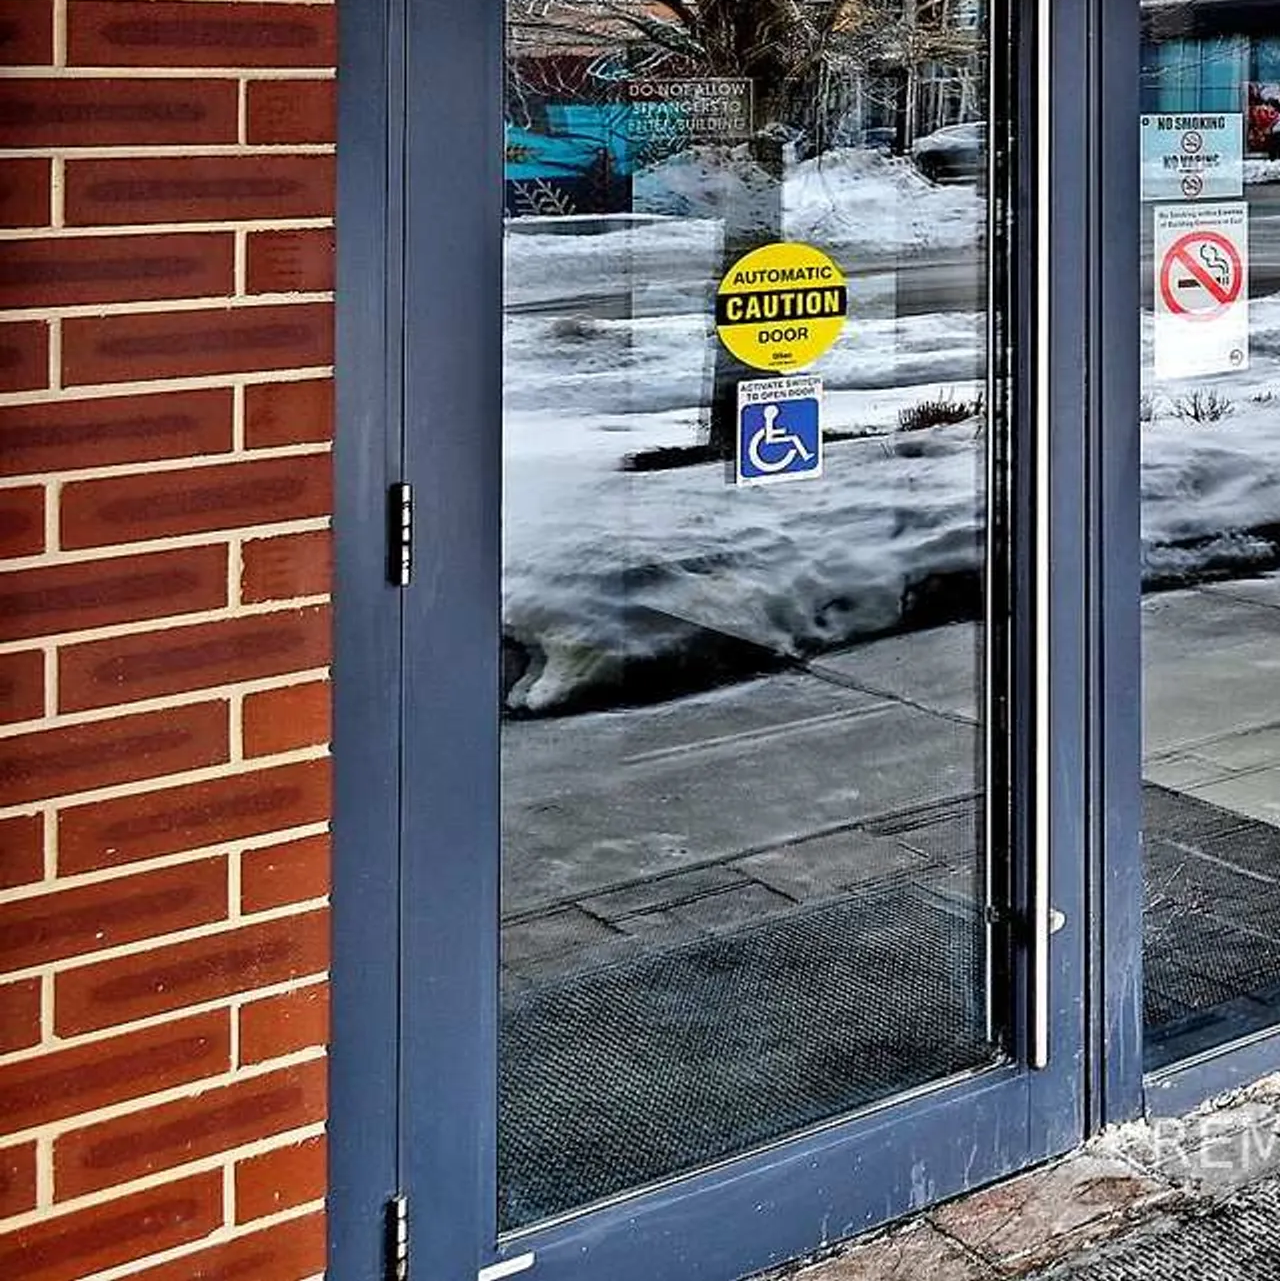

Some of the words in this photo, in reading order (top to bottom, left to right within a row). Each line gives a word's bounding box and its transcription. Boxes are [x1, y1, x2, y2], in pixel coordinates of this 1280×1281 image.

[628, 83, 654, 97] DO
[1158, 117, 1173, 130] NO
[1175, 116, 1225, 130] SMOKING
[1163, 155, 1179, 168] NO
[733, 266, 833, 285] AUTOMATIC
[726, 290, 840, 320] CAUTION
[758, 327, 809, 344] DOOR
[740, 380, 784, 392] ACTIVATE
[746, 393, 759, 401] TO
[760, 389, 787, 400] OPEN
[788, 387, 815, 396] DOOR
